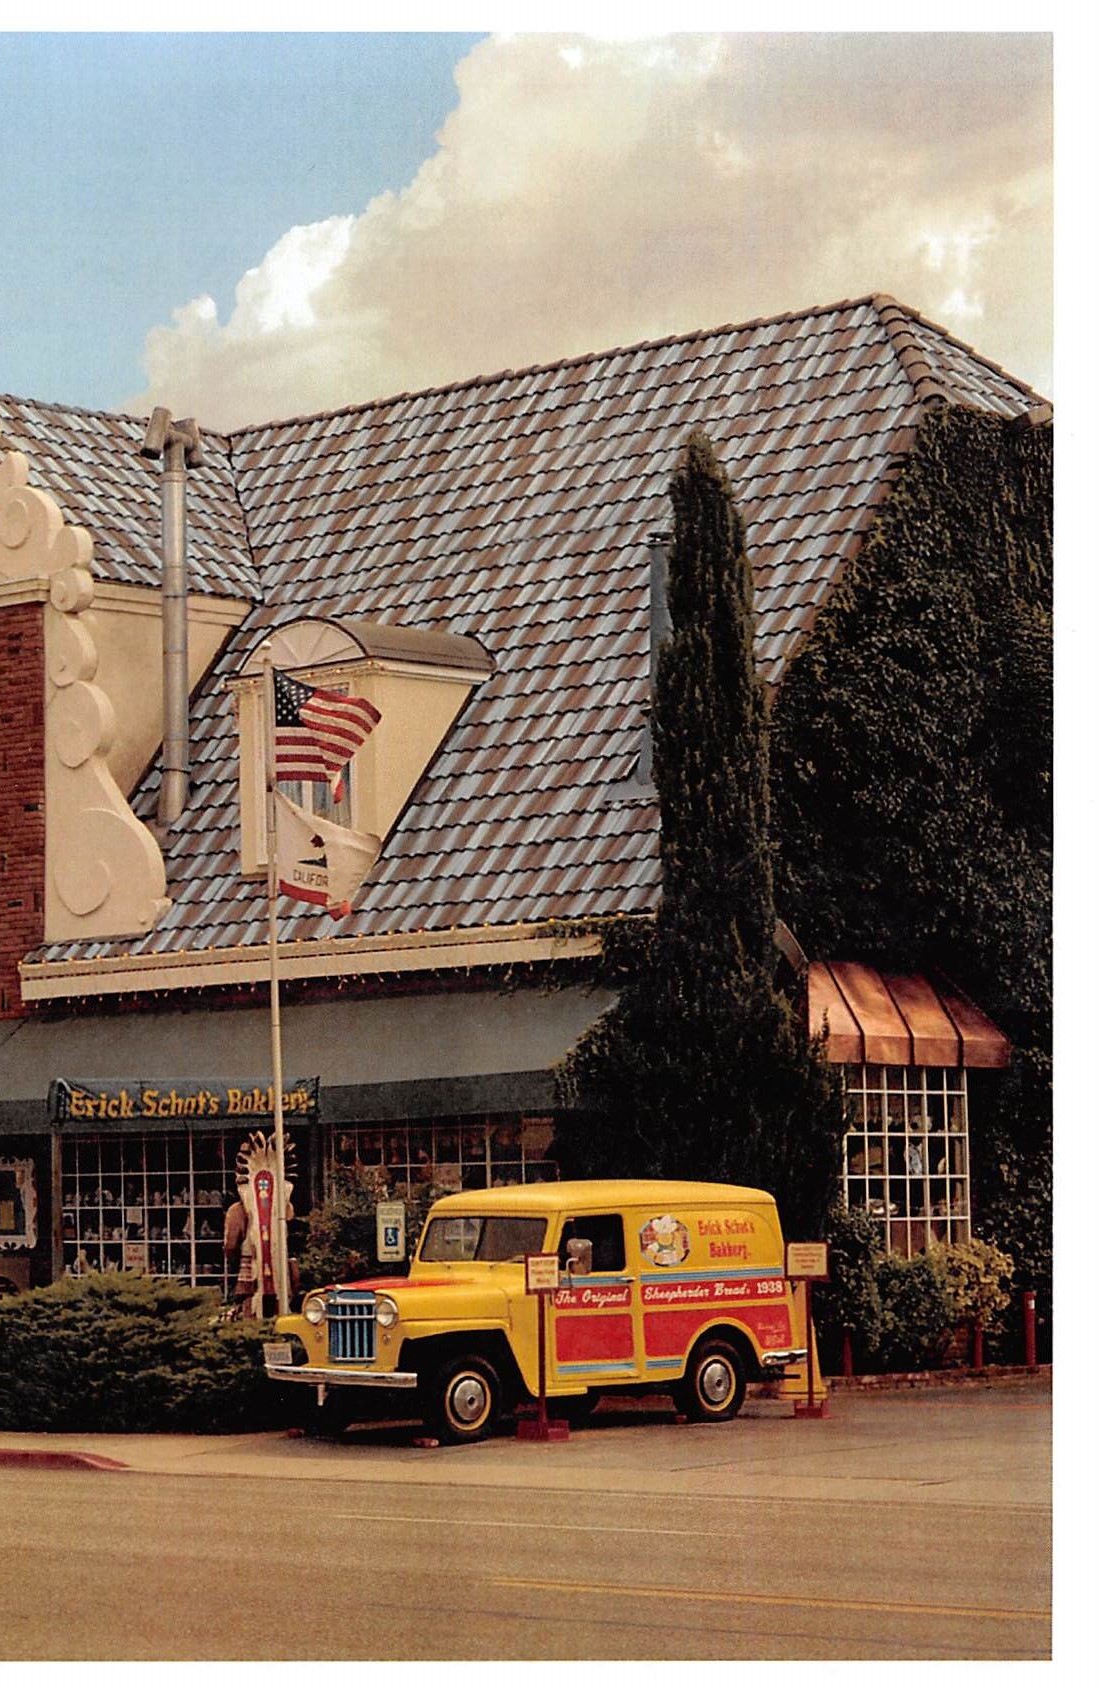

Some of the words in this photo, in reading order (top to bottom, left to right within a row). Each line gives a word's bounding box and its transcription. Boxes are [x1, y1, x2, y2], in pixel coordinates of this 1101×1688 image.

[293, 868, 328, 887] CALIFOR
[70, 1088, 133, 1118] Erick
[142, 1088, 220, 1117] Schat's
[698, 1220, 722, 1236] Erick
[556, 1290, 577, 1304] The
[582, 1288, 629, 1308] Original
[644, 1286, 710, 1302] Sheepherder
[756, 1281, 783, 1294] 1938
